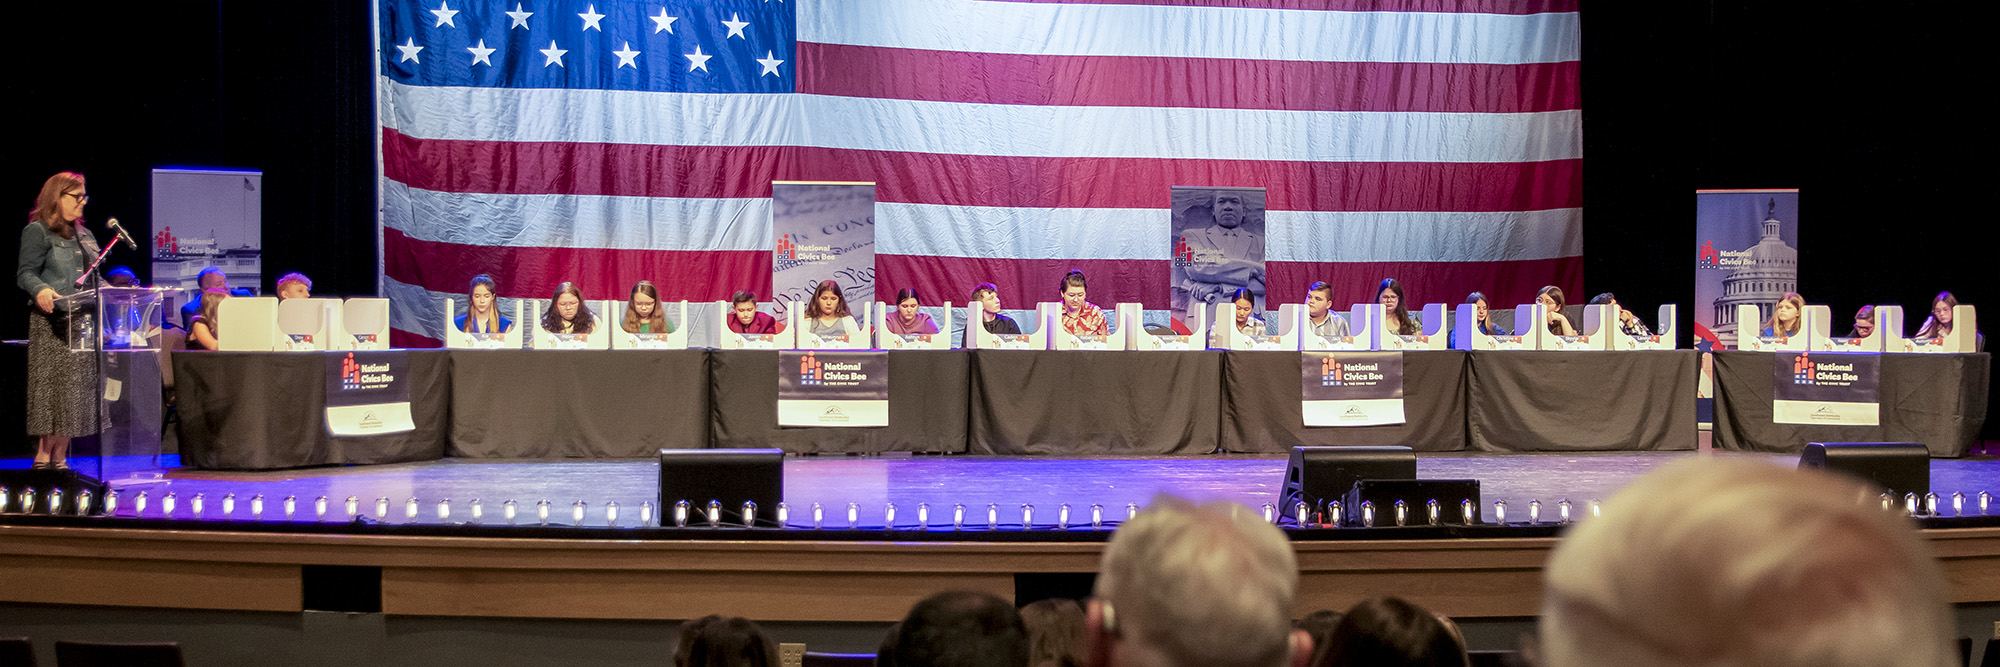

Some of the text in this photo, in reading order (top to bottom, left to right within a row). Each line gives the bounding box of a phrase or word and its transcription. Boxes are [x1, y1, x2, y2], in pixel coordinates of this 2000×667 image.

[361, 363, 390, 372] National
[824, 362, 861, 370] National
[1344, 363, 1378, 371] National
[1816, 363, 1853, 371] National
[361, 374, 394, 383] Civics Bee
[824, 372, 867, 380] Civics Bee
